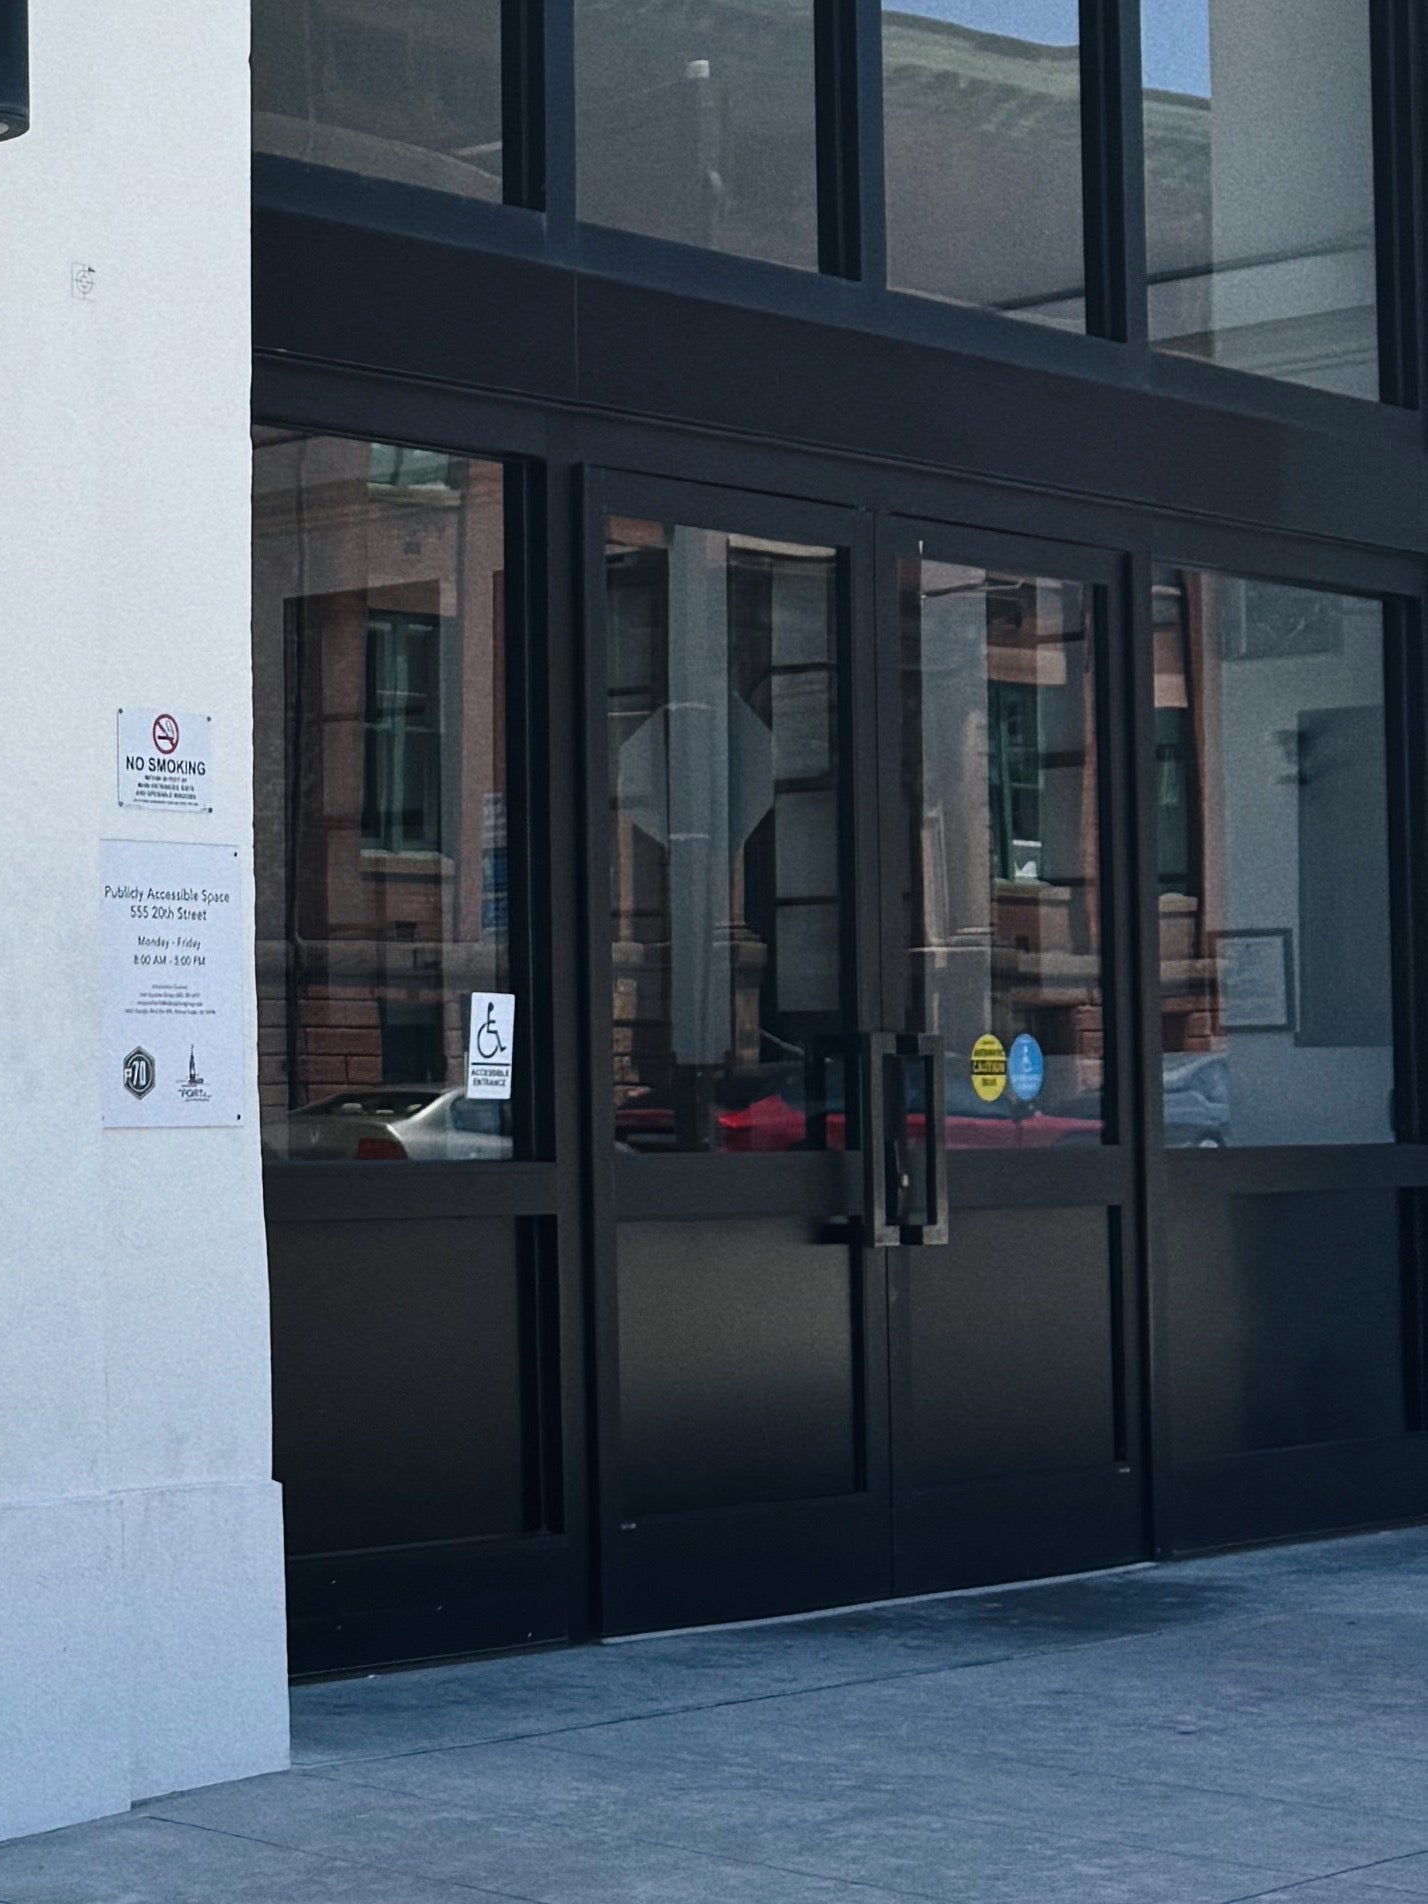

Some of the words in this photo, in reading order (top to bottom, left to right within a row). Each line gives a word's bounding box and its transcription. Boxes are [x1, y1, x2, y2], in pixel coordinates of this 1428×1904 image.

[126, 755, 145, 771] NO
[148, 757, 206, 776] SMOKING
[104, 885, 143, 902] Publicly
[147, 887, 199, 902] Accessible
[201, 889, 230, 906] Space
[130, 905, 149, 919] 555
[151, 906, 174, 920] 20th
[177, 906, 207, 921] Street
[138, 936, 169, 950] Monday
